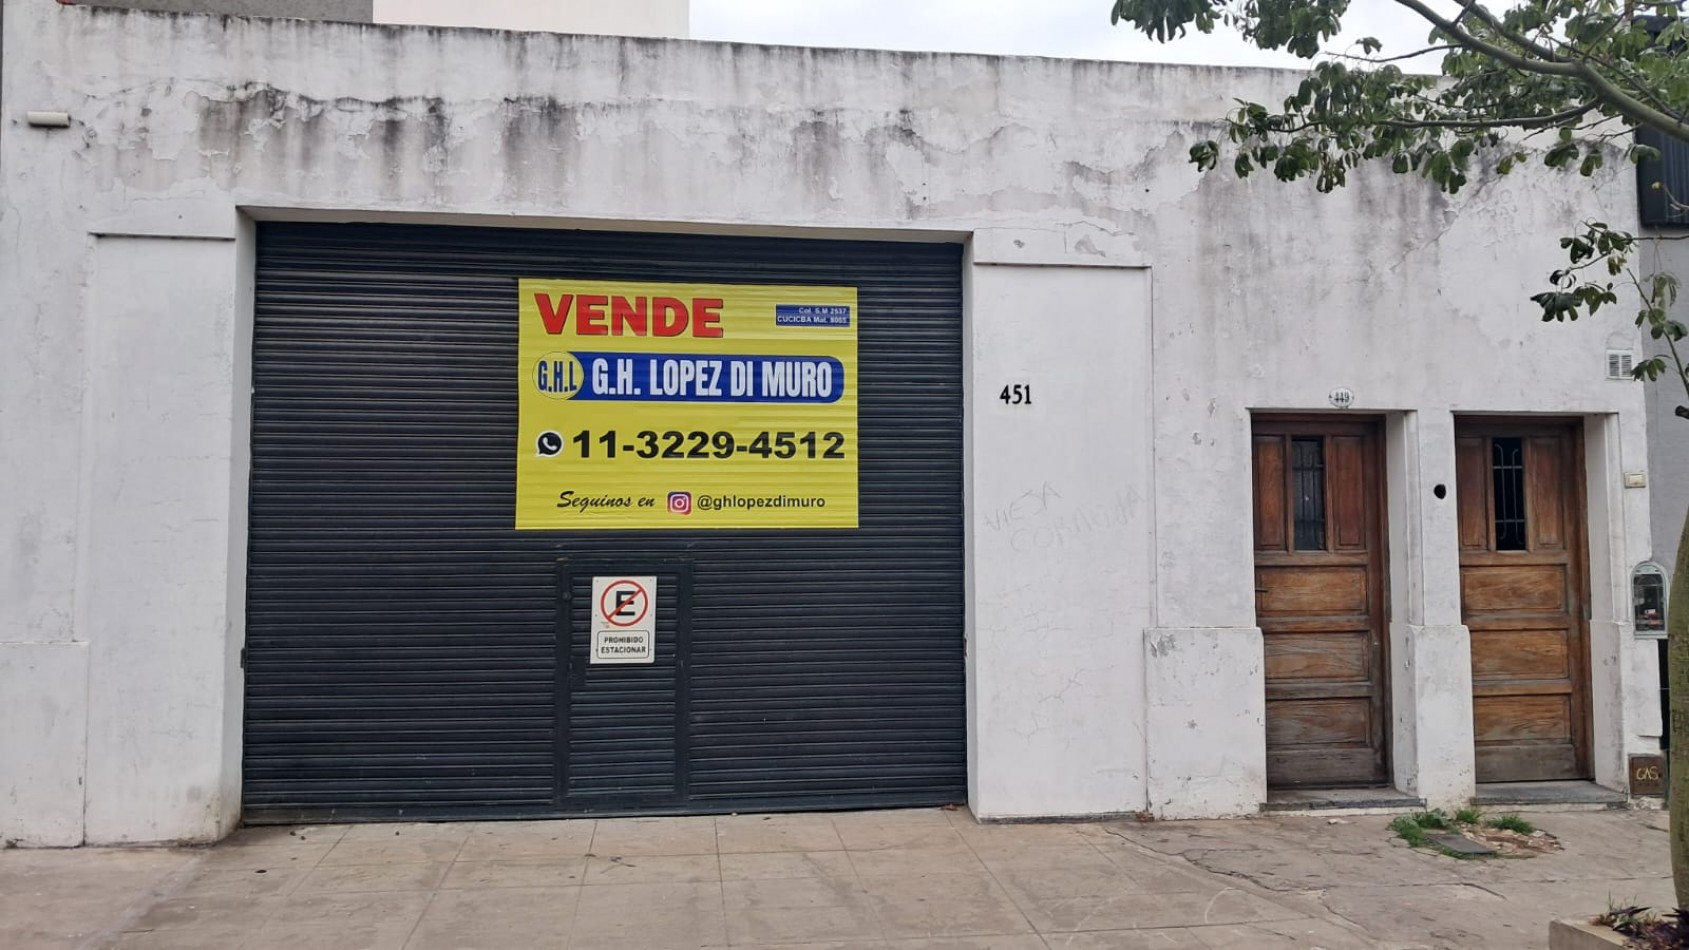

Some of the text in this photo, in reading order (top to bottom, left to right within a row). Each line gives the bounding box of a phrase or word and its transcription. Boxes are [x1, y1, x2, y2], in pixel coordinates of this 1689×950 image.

[534, 293, 724, 338] VENDE
[777, 315, 812, 323] CUCICBA
[537, 360, 577, 392] G.H.L
[592, 358, 832, 398] G.H. LOPEZ DI MURO
[1000, 384, 1032, 405] 451
[1334, 391, 1350, 403] 449
[572, 430, 846, 459] 11-3229-4512
[556, 490, 826, 513] Seguinos en @ghlopezdimuro
[615, 590, 635, 616] E
[601, 646, 646, 654] ESTACIONAR
[604, 636, 643, 644] PROHIBIDO
